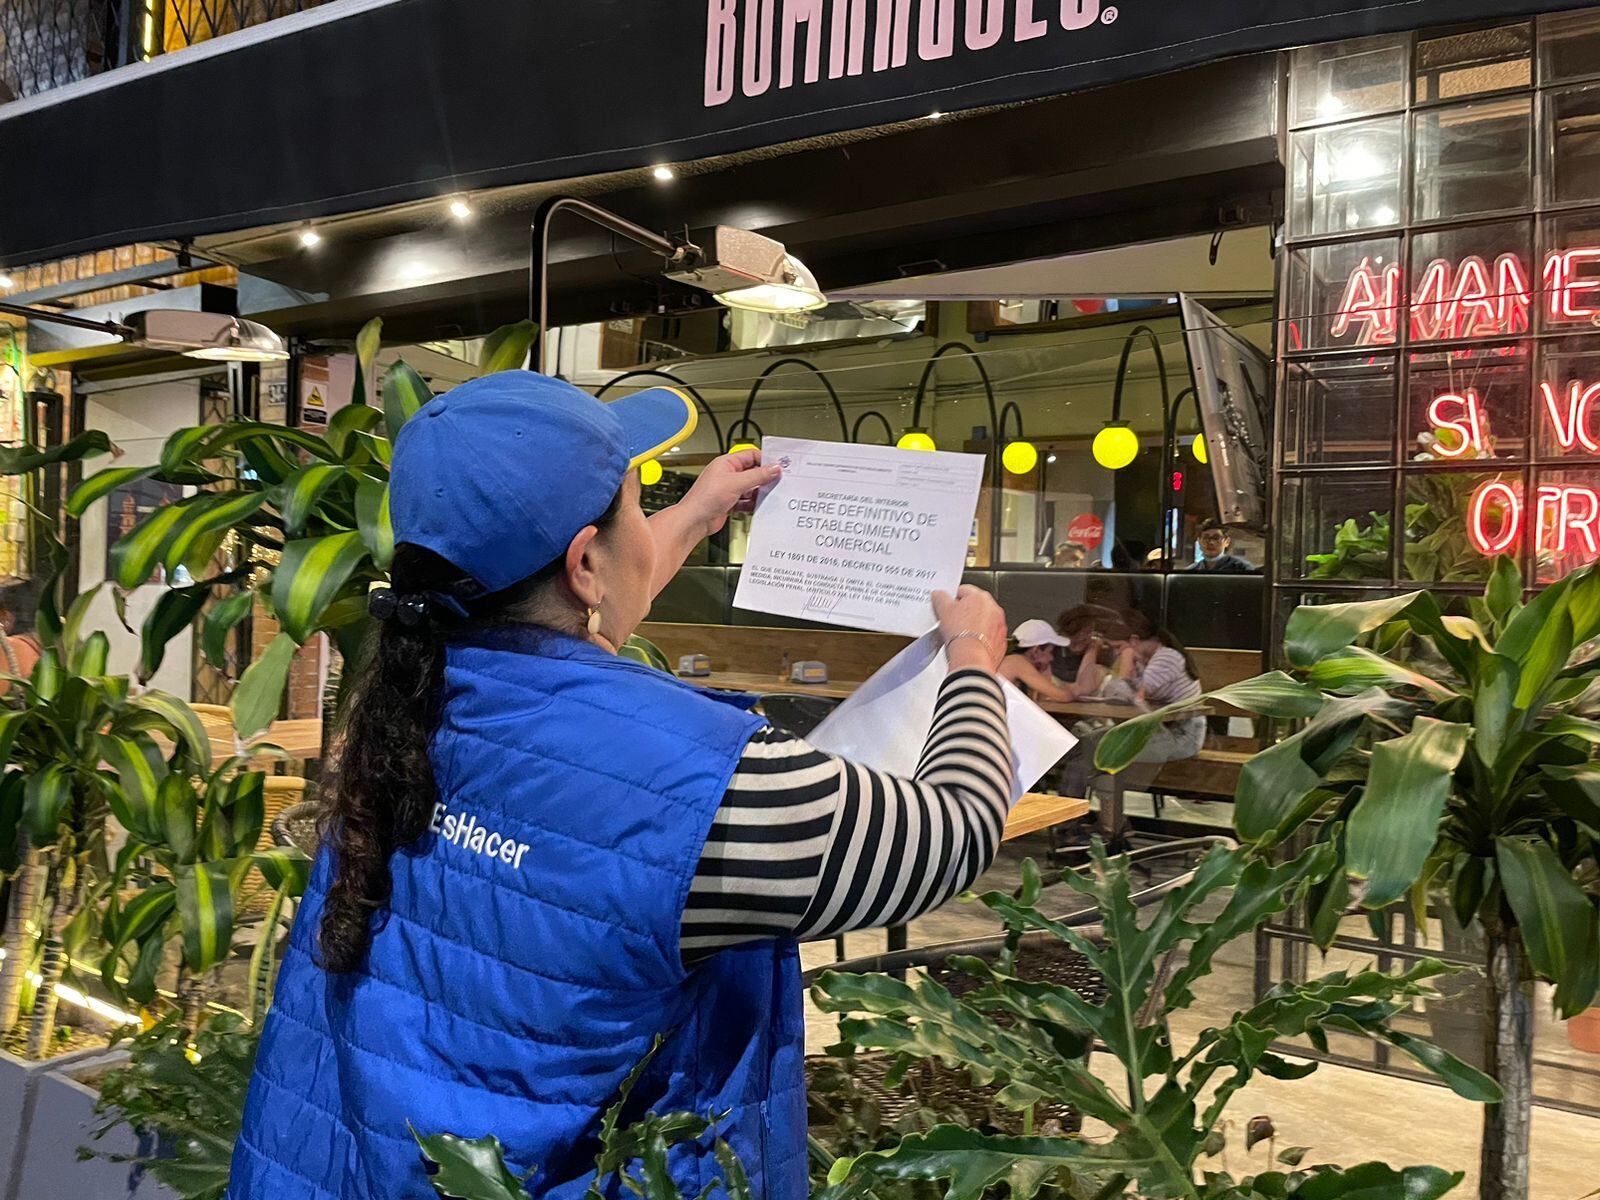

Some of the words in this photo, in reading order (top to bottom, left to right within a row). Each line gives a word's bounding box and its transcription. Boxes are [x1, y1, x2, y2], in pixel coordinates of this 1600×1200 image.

[788, 499, 835, 515] CIERRE
[837, 504, 914, 525] DEFINITIVO
[917, 513, 938, 527] DE
[861, 496, 874, 505] DEL
[875, 497, 910, 507] INTERIOR
[796, 516, 921, 542] ESTABLECIMIENTO
[1474, 483, 1600, 553] OTR
[814, 534, 893, 556] COMERCIAL
[769, 550, 786, 559] LEY
[787, 552, 805, 561] 1801
[806, 554, 819, 564] DE
[841, 559, 883, 573] DECRETO
[901, 567, 915, 577] DE
[428, 802, 530, 869] EsHacer
